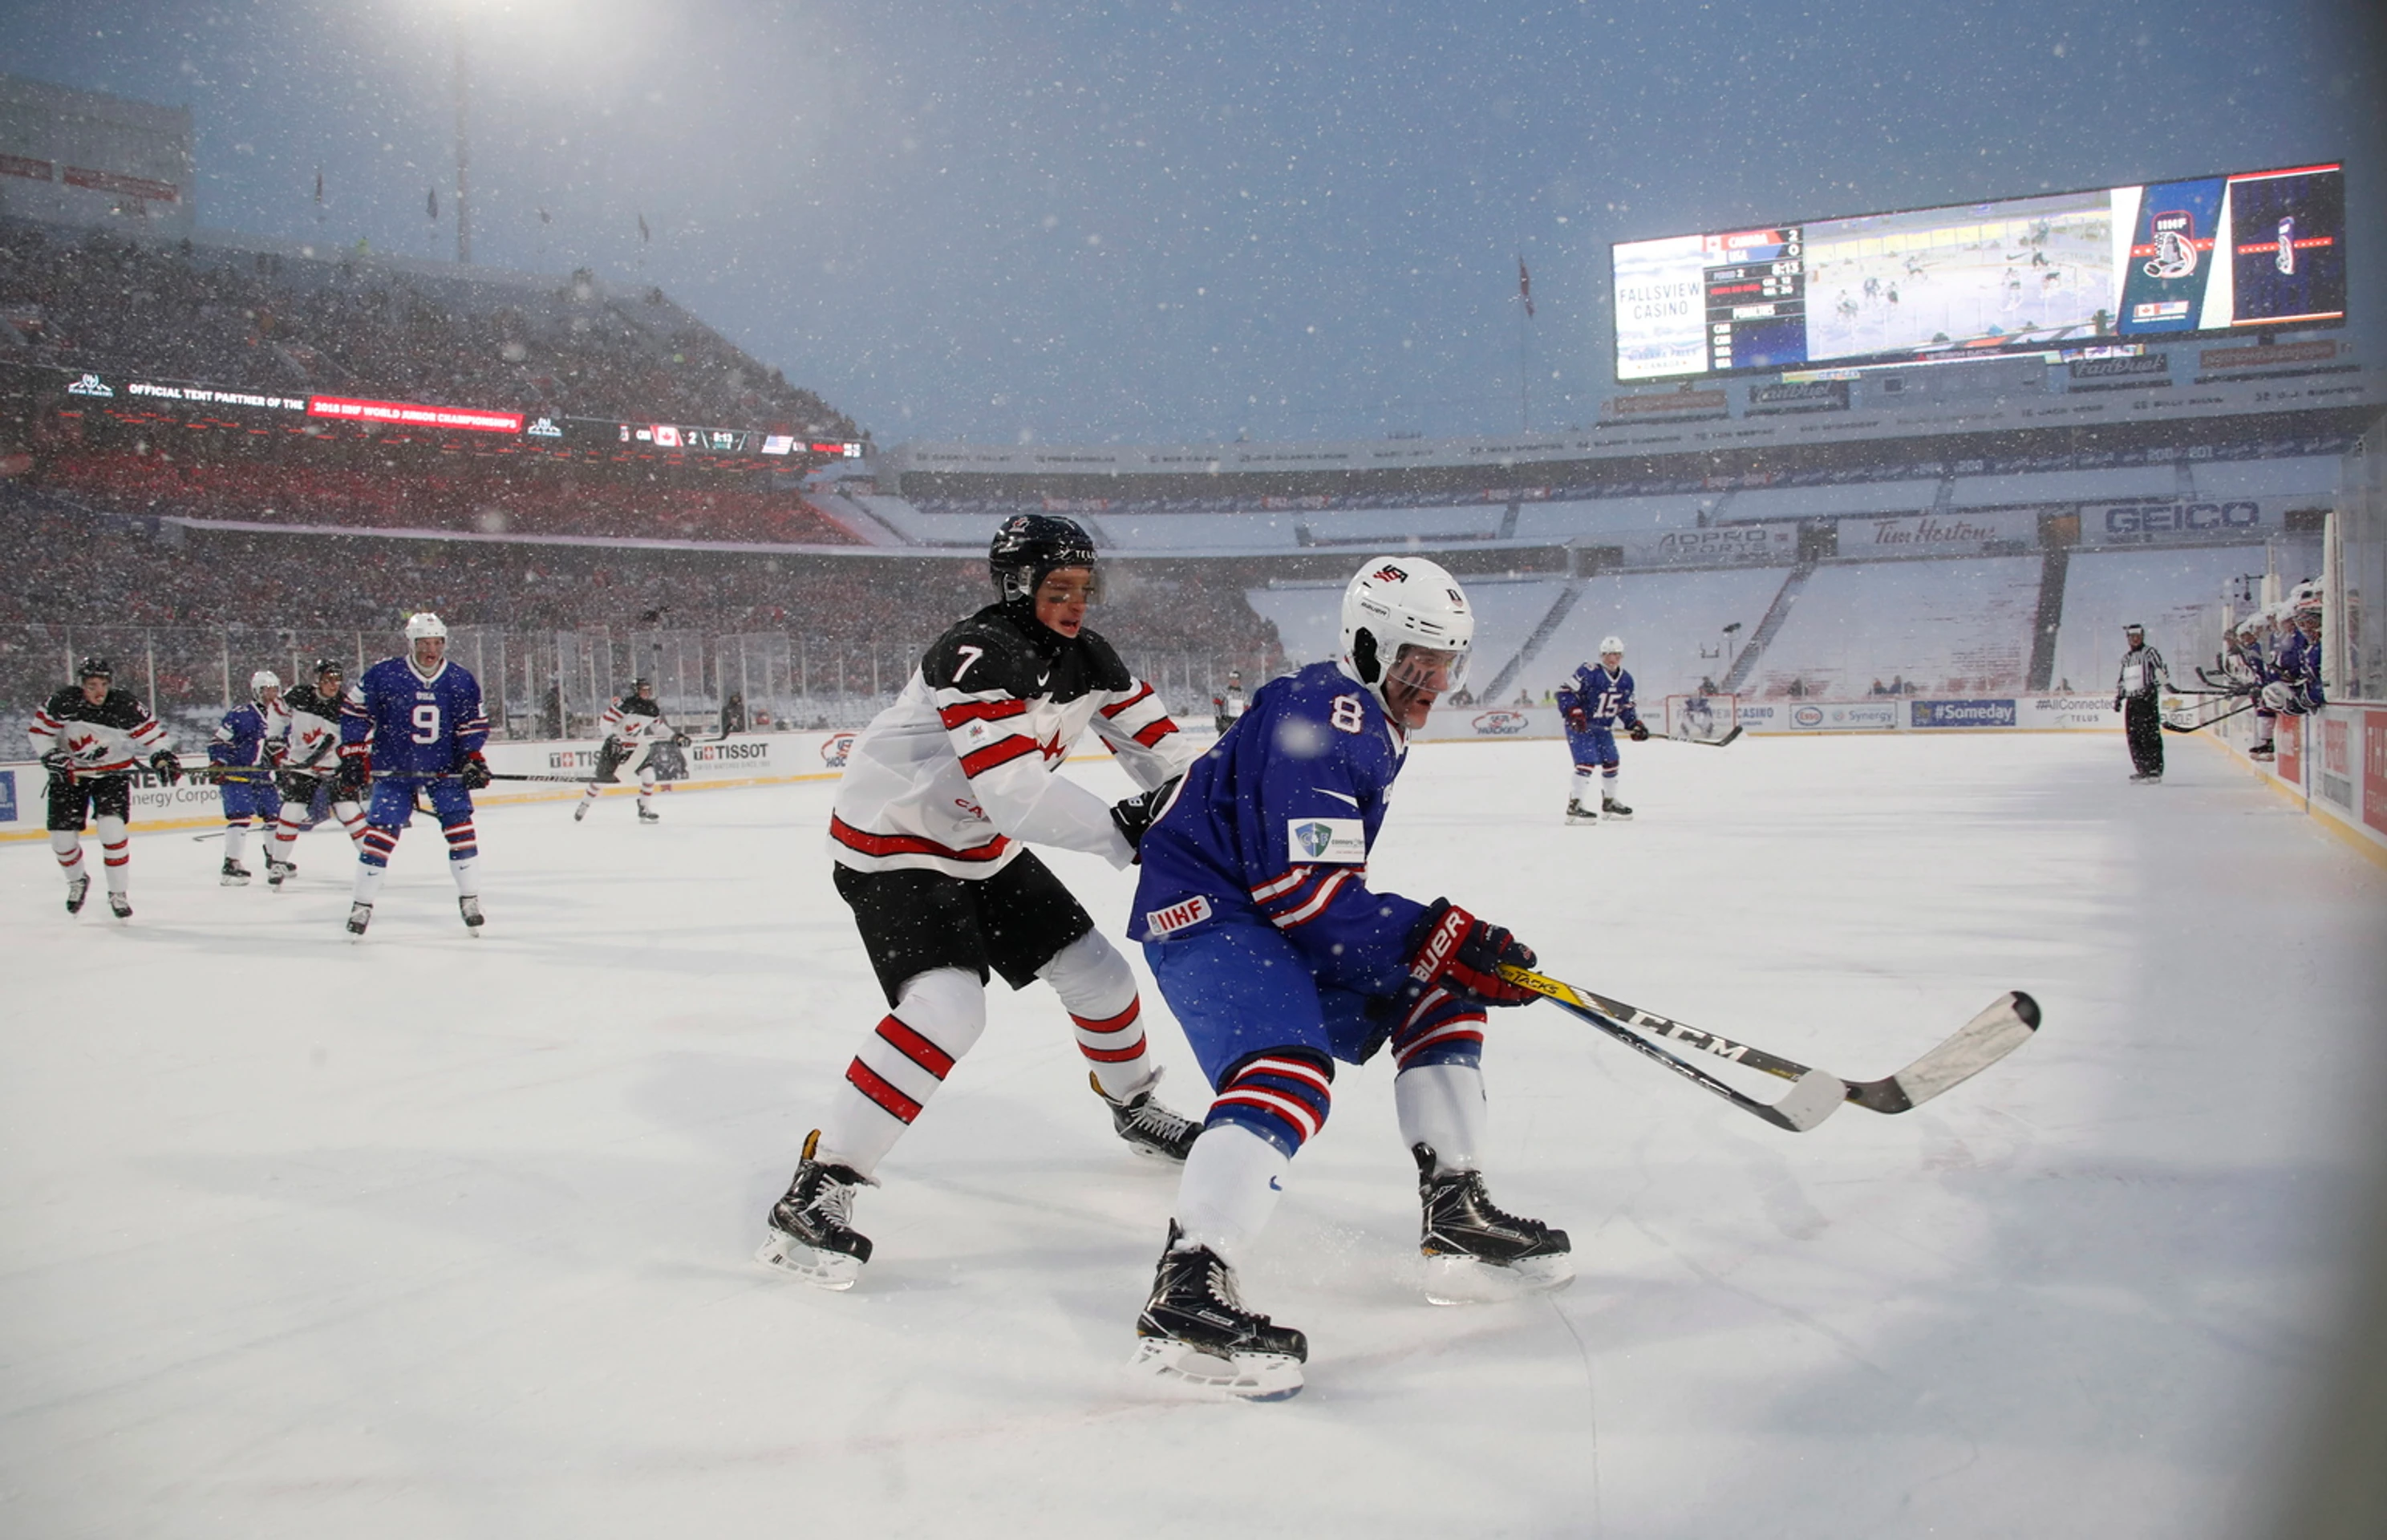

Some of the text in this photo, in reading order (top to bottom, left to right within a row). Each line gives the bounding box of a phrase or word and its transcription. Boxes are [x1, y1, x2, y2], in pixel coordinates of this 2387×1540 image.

[2157, 217, 2187, 231] IIHF
[1788, 229, 1798, 242] 2
[1788, 244, 1800, 256] 0
[1771, 261, 1800, 277] 8:13
[1619, 282, 1701, 303] FALLSVIEW
[1633, 300, 1688, 320] CASINO
[2074, 354, 2162, 379] FanDuel
[128, 383, 182, 399] OFFICIAL
[183, 388, 213, 402] TENT
[214, 391, 265, 407] PARTNER
[267, 398, 282, 408] OF
[283, 398, 305, 411] THE
[314, 402, 340, 413] 2018
[363, 406, 401, 419] WORLD
[437, 412, 517, 429] CHAMPIONSHIPS
[688, 430, 697, 445] 2
[2105, 500, 2260, 533] GEICO
[1659, 529, 1768, 549] ADPRO
[1874, 518, 1996, 544] Tim Hortons
[1664, 541, 1767, 554] SPORTS
[951, 645, 983, 683] 7
[415, 691, 436, 701] USA
[1330, 695, 1364, 734] 8
[1593, 692, 1623, 719] 15
[1737, 707, 1775, 719] CASINO
[1935, 704, 2014, 721] #Someday
[411, 705, 441, 744] 9
[1799, 711, 1820, 720] Esso
[1849, 710, 1893, 723] Synergy
[1477, 726, 1521, 735] HOCKEY
[575, 751, 601, 767] TIS
[715, 744, 768, 760] TISSOT
[826, 756, 847, 768] HOC
[130, 788, 223, 807] nergy Corpo
[1157, 899, 1204, 933] IIHF
[1628, 1009, 1749, 1063] CCM
